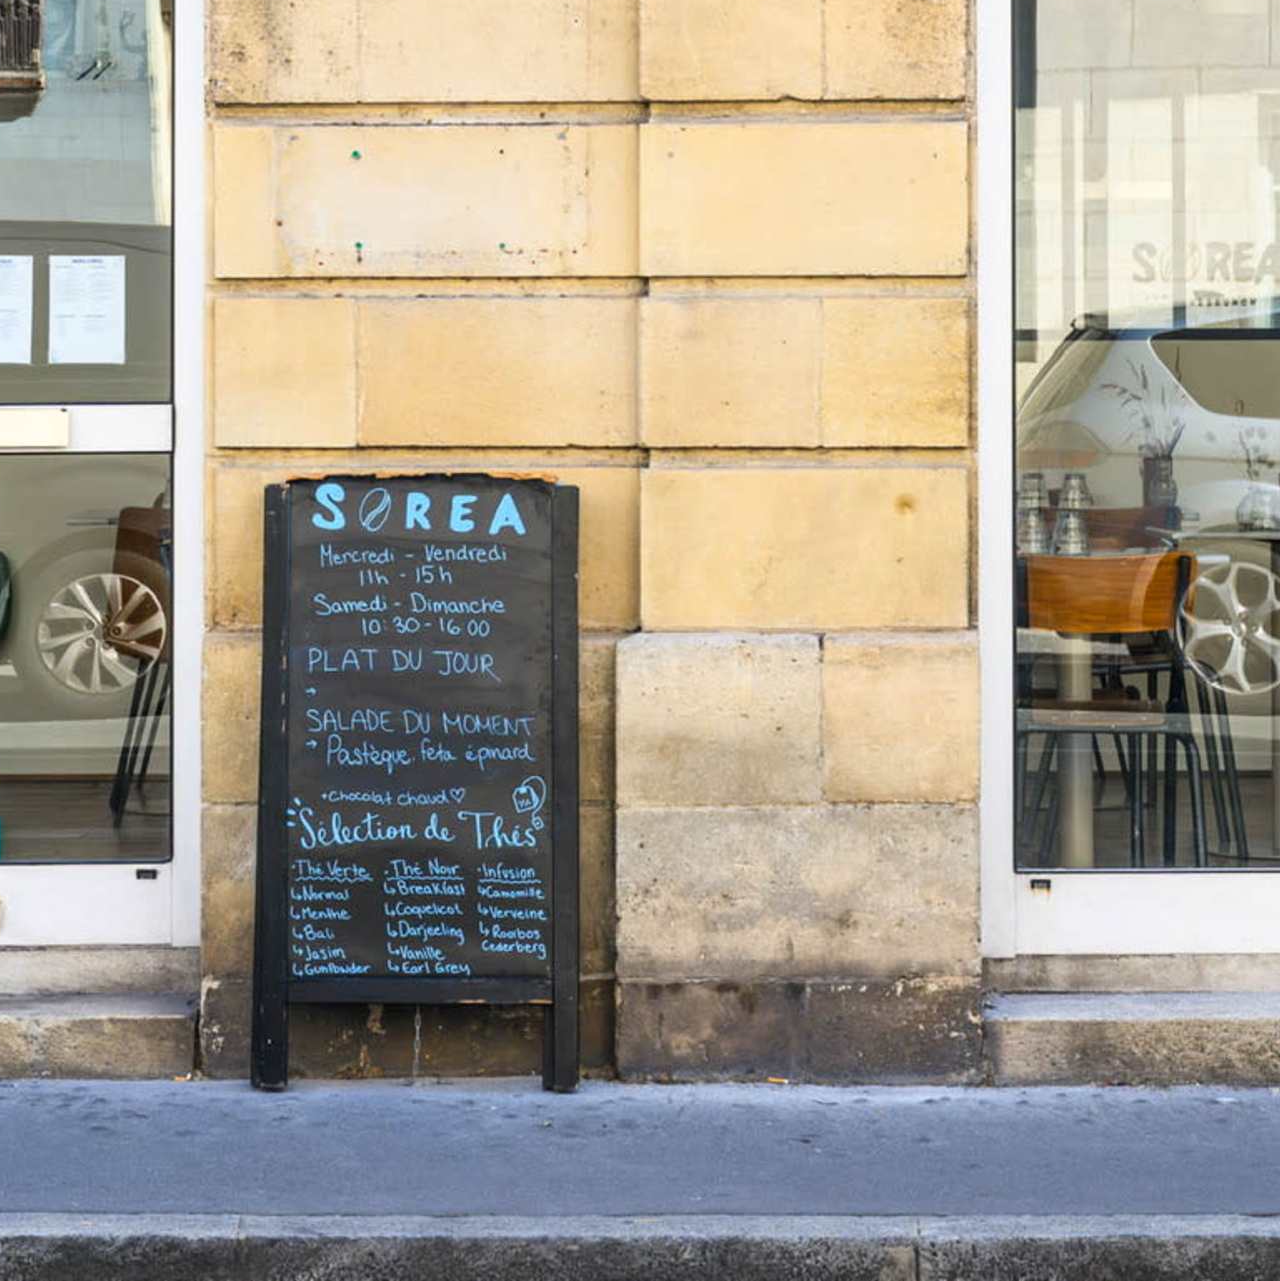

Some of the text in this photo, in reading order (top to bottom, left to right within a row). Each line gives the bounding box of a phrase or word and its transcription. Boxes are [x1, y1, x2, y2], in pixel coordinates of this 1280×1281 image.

[320, 543, 395, 568] Mercredi
[424, 544, 507, 563] Vendredi
[313, 593, 387, 615] Samedi
[410, 592, 506, 613] Dimanche
[308, 648, 502, 683] PLAT DU JOUR
[306, 709, 536, 737] SALADE DU MOMENT
[328, 789, 449, 806] Chocolat chaud
[299, 807, 537, 850] Sélection de Thés
[326, 859, 371, 876] Verte
[428, 856, 461, 876] Noir
[481, 861, 537, 879] Infusion
[302, 885, 350, 901] Normal
[397, 879, 466, 896] Breakfast
[302, 906, 352, 921] Menthe
[488, 904, 548, 921] Verveine
[399, 920, 466, 946] Darjeeling
[401, 945, 447, 961] Vanille
[402, 960, 471, 977] Earl Grey
